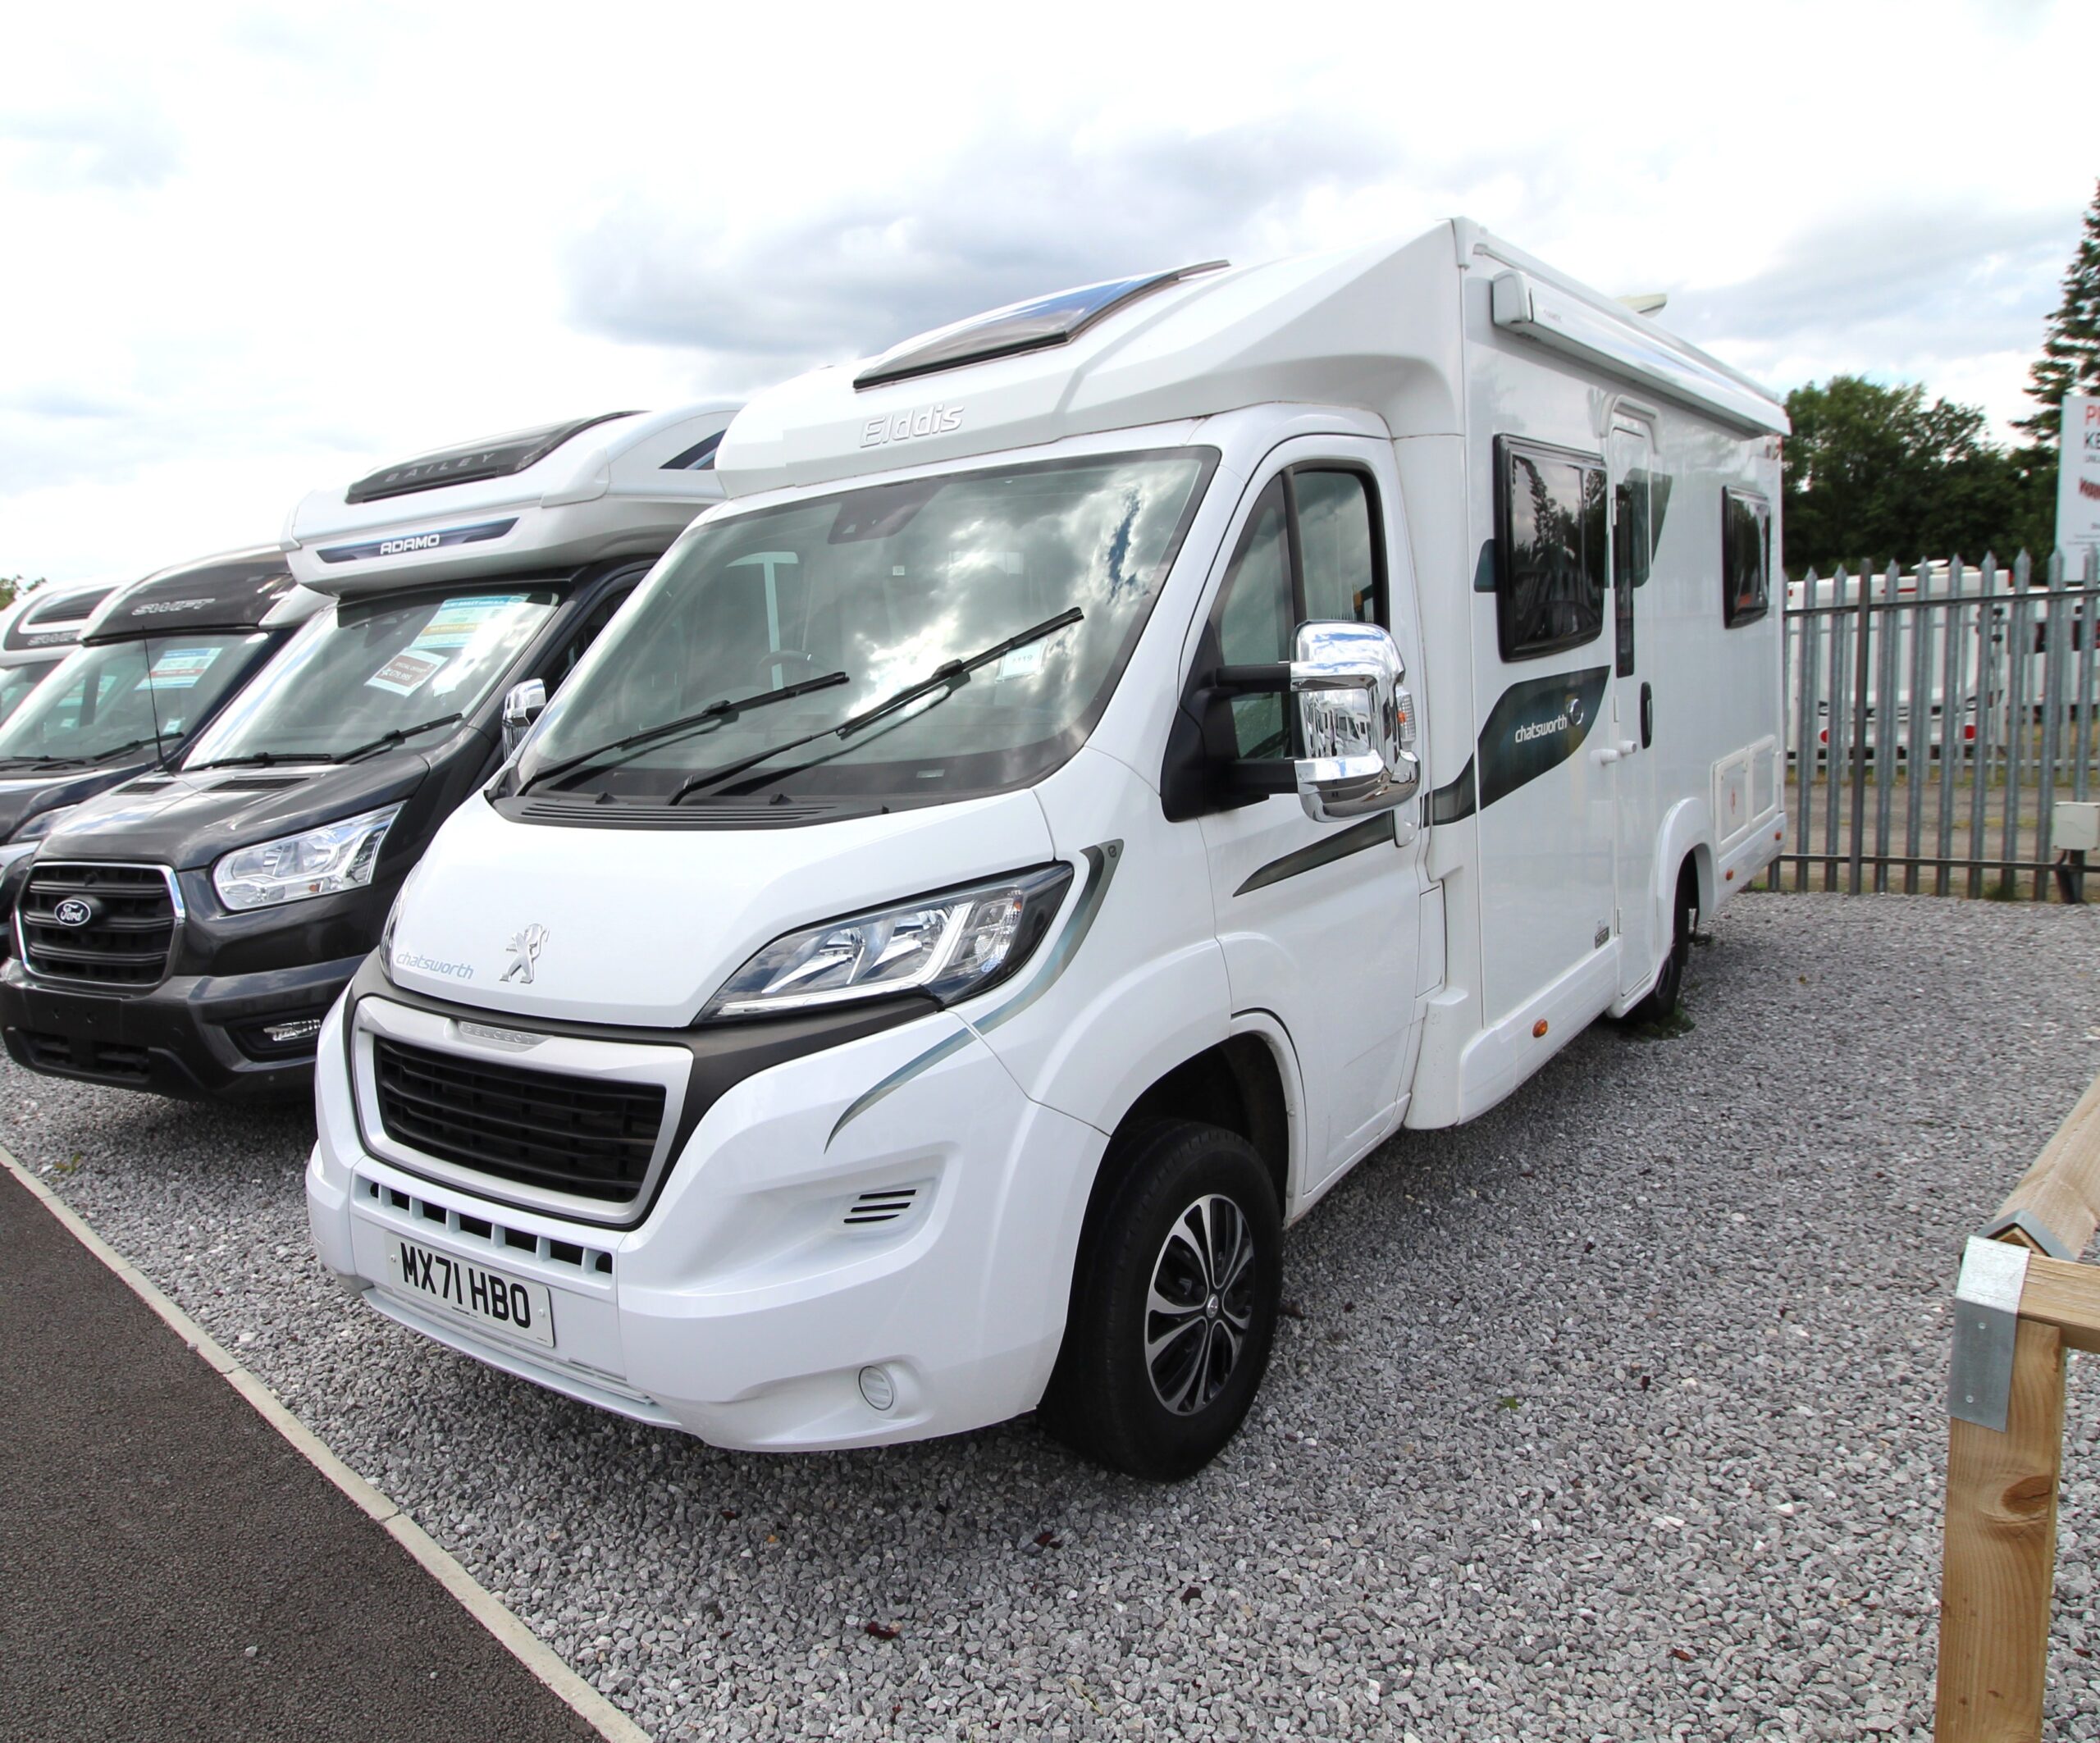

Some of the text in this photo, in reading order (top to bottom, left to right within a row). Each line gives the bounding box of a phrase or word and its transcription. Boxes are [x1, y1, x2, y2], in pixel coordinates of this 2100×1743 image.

[860, 404, 965, 449] Elddis
[385, 453, 495, 482] BAILEY
[380, 534, 440, 554] ADAMO
[131, 598, 215, 616] SWIFT
[1515, 714, 1568, 743] chatsworth
[60, 903, 84, 921] Ford
[396, 951, 474, 979] chatsworth
[400, 1242, 531, 1329] MX71 HBO
